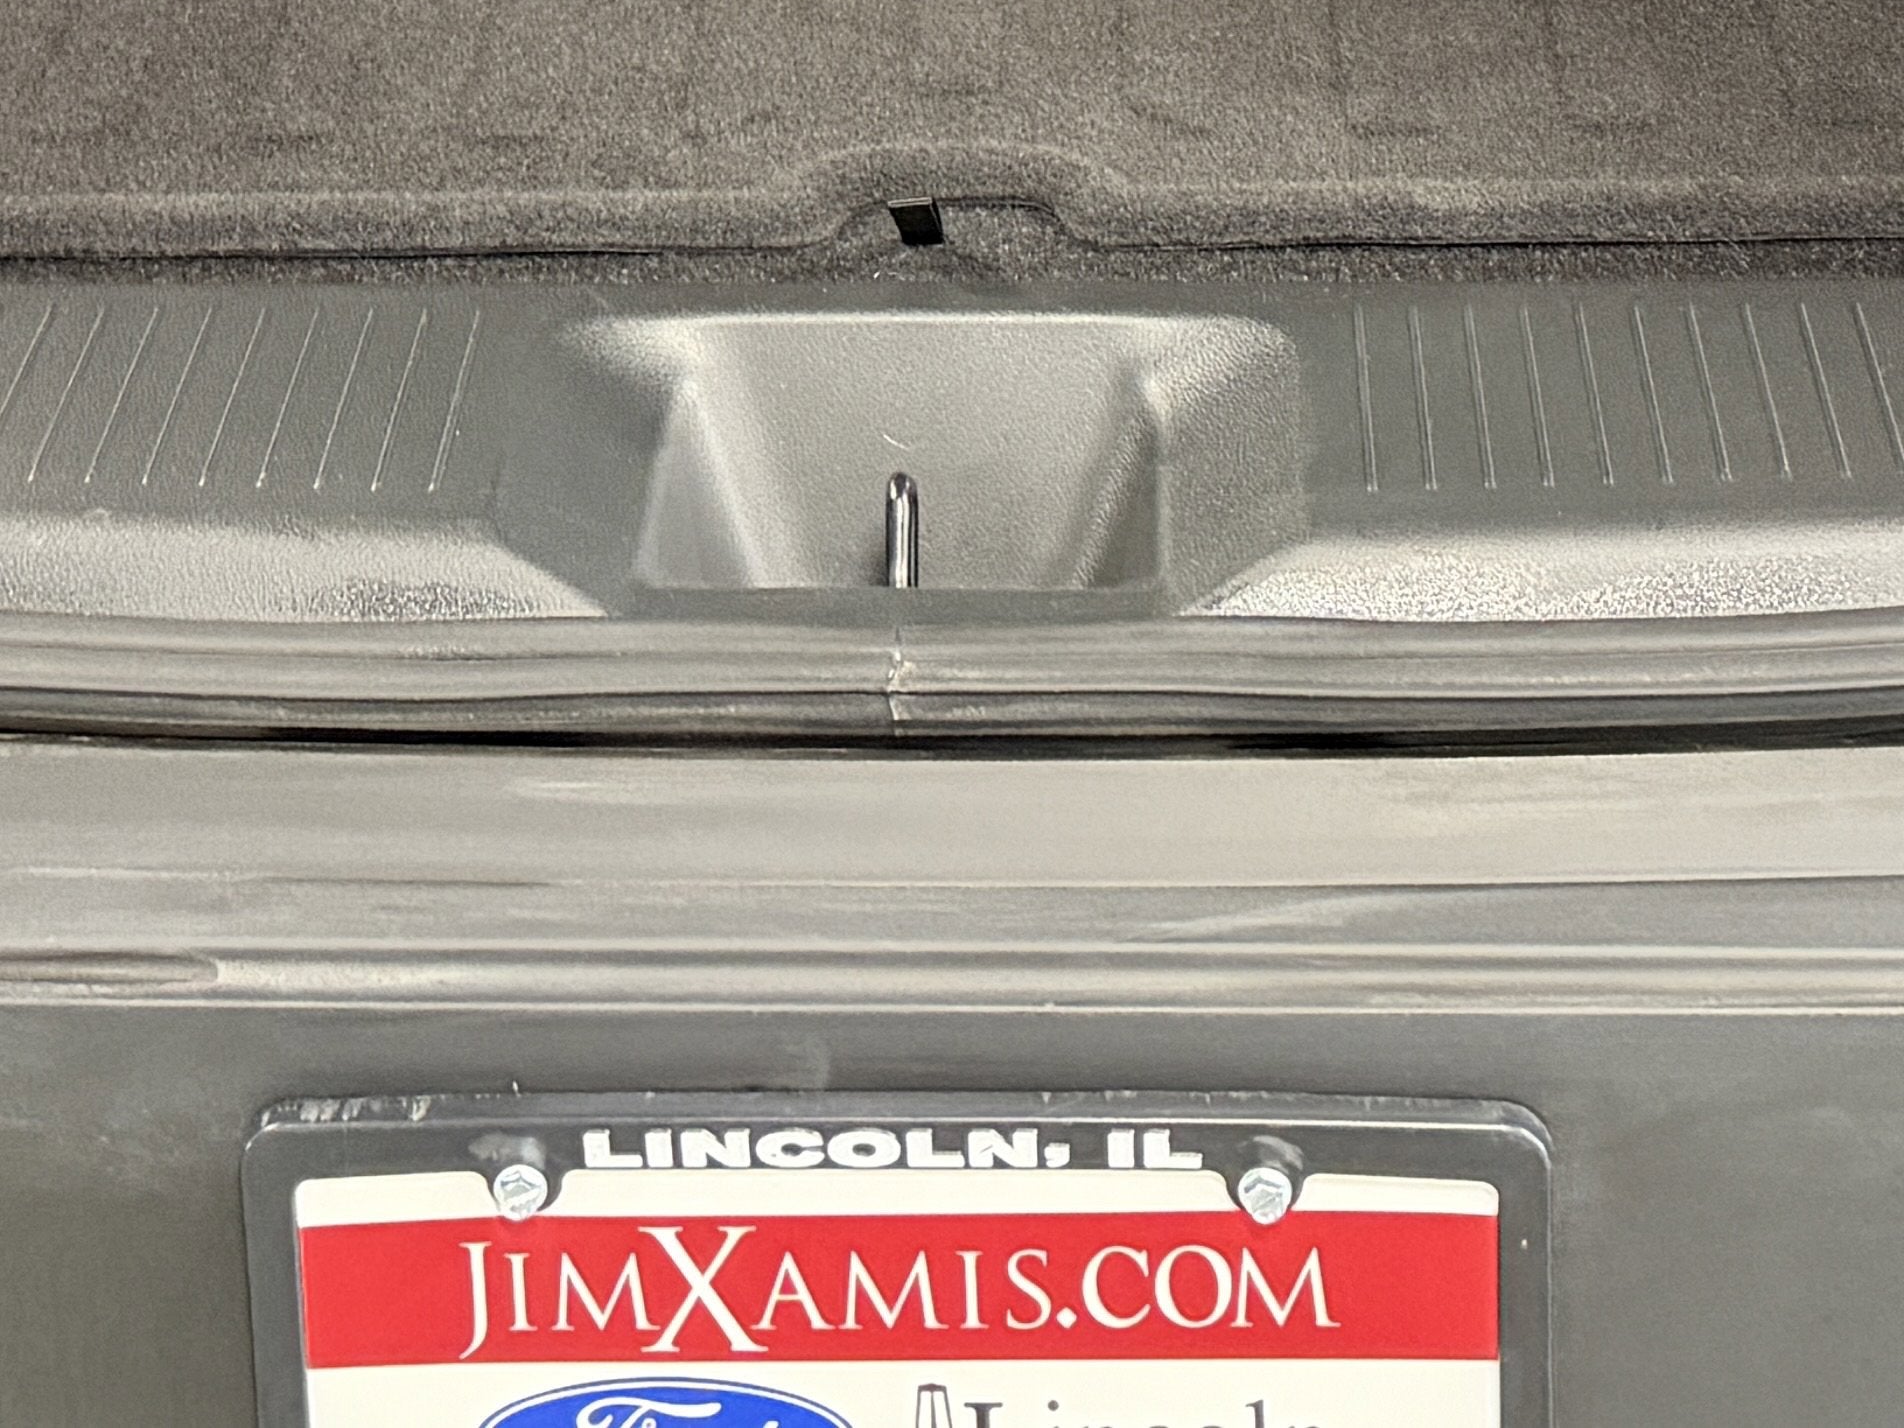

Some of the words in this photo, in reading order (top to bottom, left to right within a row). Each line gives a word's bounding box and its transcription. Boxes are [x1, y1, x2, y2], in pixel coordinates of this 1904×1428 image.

[582, 1128, 1071, 1169] LINCOLN,
[1107, 1128, 1202, 1169] IL
[458, 1225, 1341, 1359] JIMXAMIS.COM
